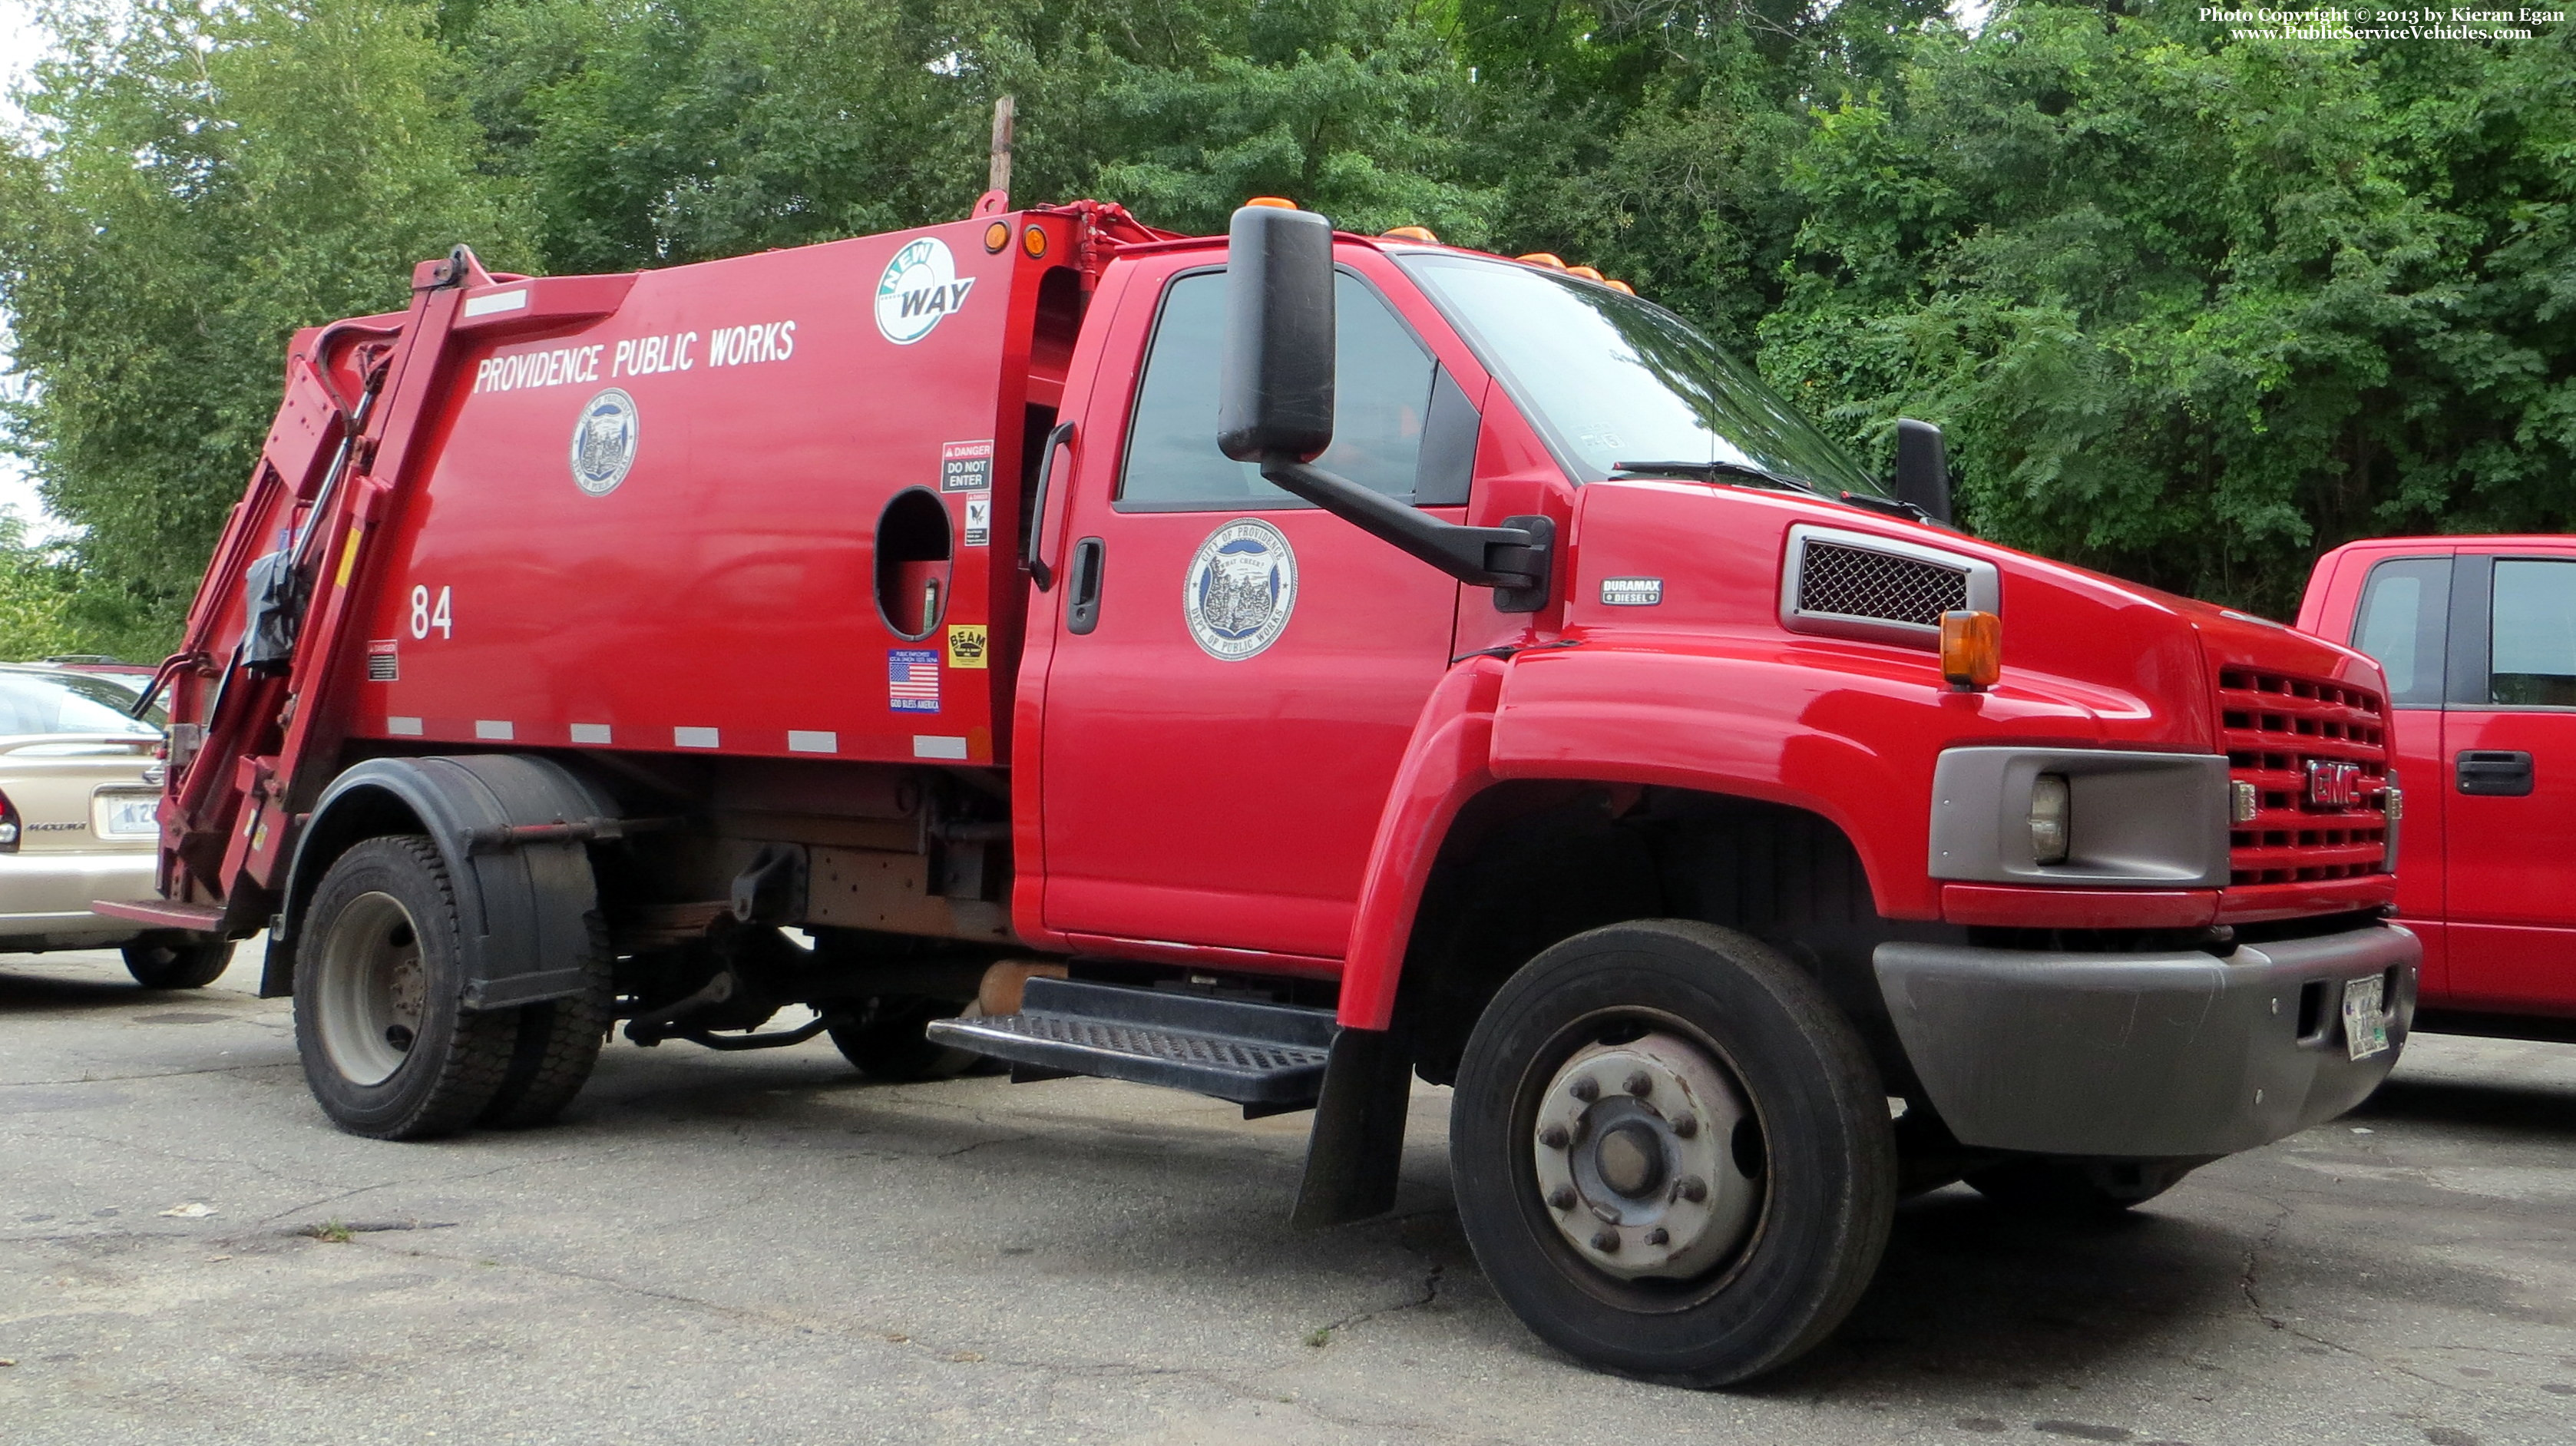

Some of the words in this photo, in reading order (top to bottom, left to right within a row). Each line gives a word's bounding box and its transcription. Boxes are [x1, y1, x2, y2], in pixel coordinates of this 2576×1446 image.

[883, 243, 931, 290] NEW
[901, 281, 973, 319] WAY
[473, 344, 604, 394] PROVIDENCE
[612, 331, 697, 378] PUBLIC
[709, 319, 796, 368] WORKS
[954, 445, 991, 458] DANGER
[947, 462, 963, 474] DO
[964, 460, 987, 473] NOT
[950, 474, 983, 487] ENTER
[1201, 540, 1222, 562] CITY
[1222, 530, 1233, 540] OF
[1237, 526, 1286, 561] PROVIDENCE
[1220, 558, 1238, 568] WHAT
[1603, 580, 1661, 591] DURAMAX
[1614, 594, 1648, 602] DIESEL
[411, 584, 452, 640] 84
[1208, 634, 1220, 645] OF
[1221, 639, 1254, 653] PUBLIC
[1256, 608, 1283, 642] WORKS
[950, 630, 986, 648] BEAM
[890, 699, 902, 708] GOD
[2311, 763, 2361, 803] GMC
[27, 822, 88, 832] MAXIMA
